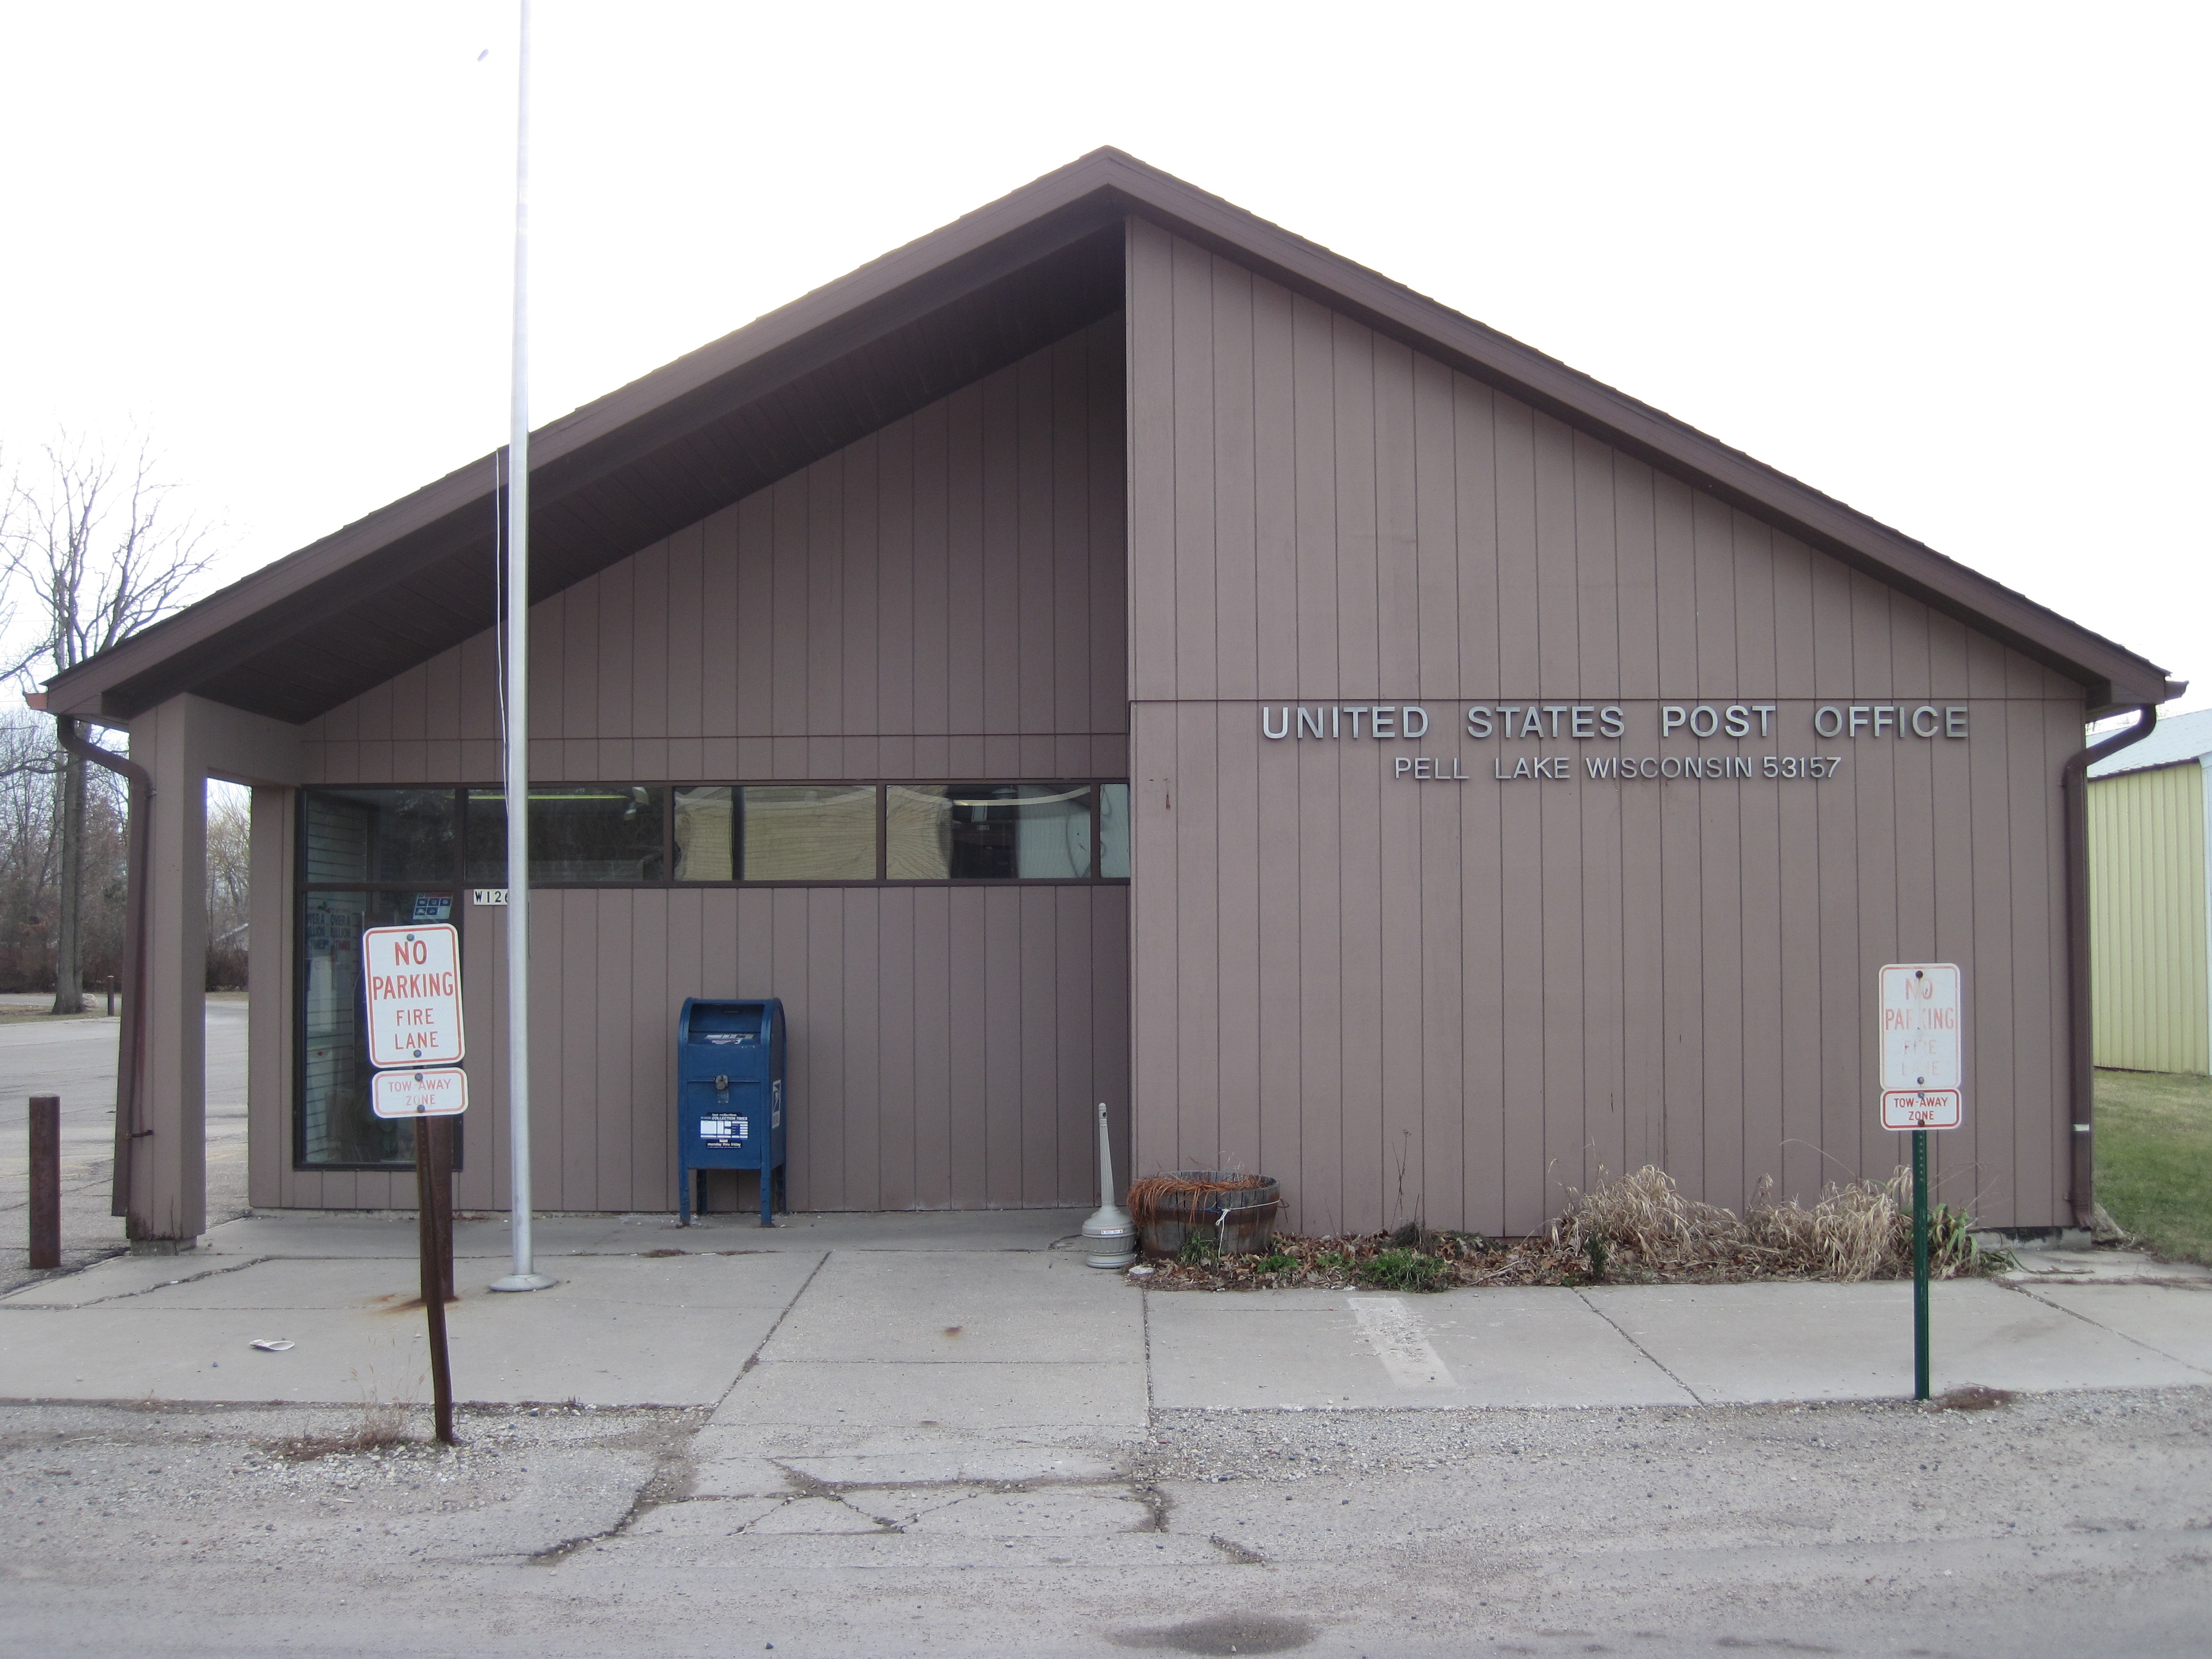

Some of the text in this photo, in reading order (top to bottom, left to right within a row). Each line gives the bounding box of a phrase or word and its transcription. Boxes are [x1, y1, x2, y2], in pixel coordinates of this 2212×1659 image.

[1262, 705, 1969, 739] UNITED STATES POST OFFICE
[1394, 756, 1841, 779] PELL LAKE WISCONSIN 53157
[395, 940, 427, 966] NO
[373, 972, 453, 1000] PARKING
[1905, 978, 1933, 1000] NO
[397, 1008, 434, 1026] FIRE
[395, 1031, 439, 1050] LANE
[388, 1079, 451, 1092] TOW-AWAY
[406, 1094, 436, 1106] ZONE
[1893, 1097, 1948, 1108] TOW-AWAY
[1908, 1110, 1934, 1120] ZONE
